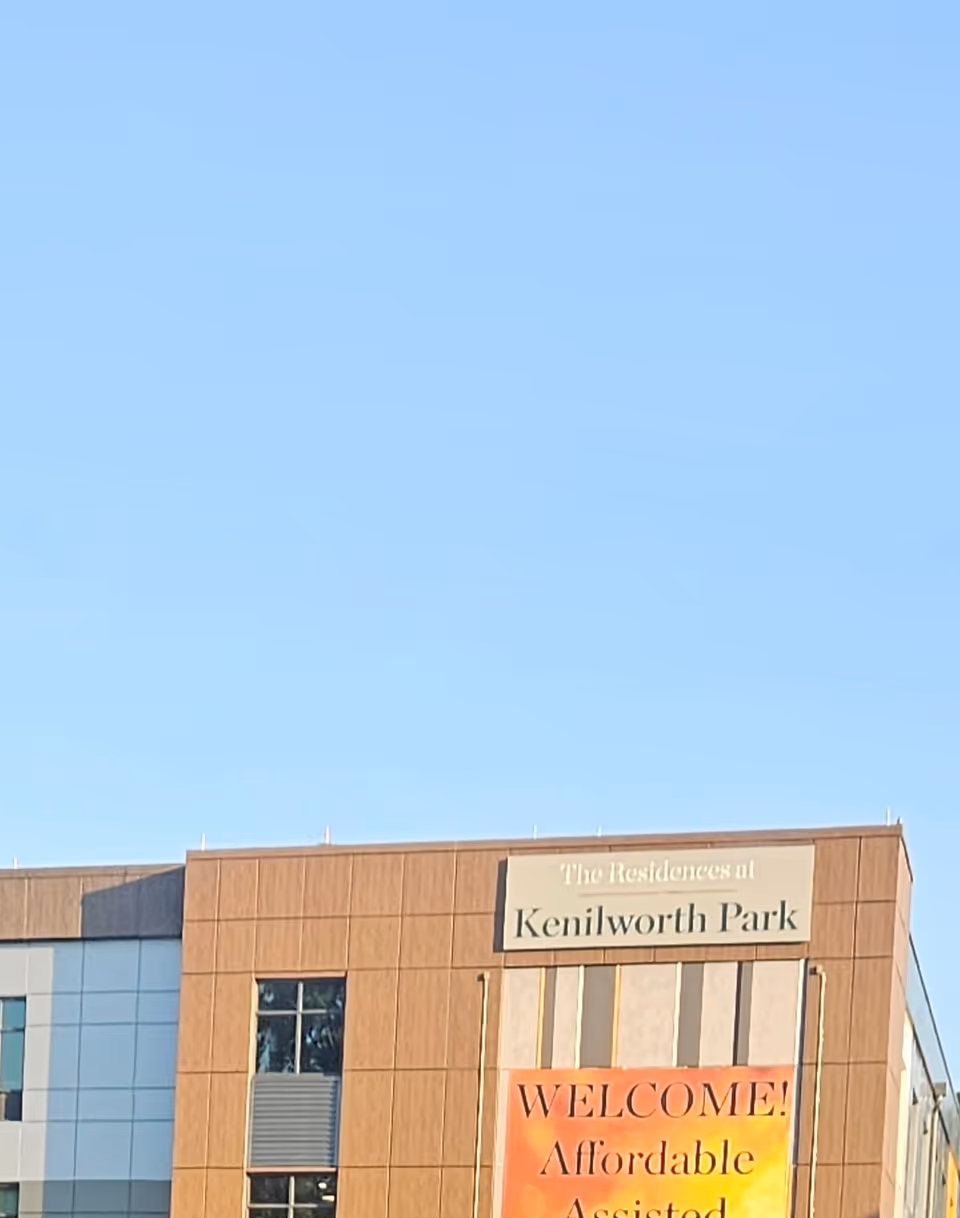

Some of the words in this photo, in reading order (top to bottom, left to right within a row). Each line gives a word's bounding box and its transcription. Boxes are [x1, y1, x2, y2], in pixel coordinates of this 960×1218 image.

[560, 862, 603, 885] The
[608, 859, 731, 883] Residences
[735, 859, 756, 880] at
[514, 903, 707, 939] Kenilworth
[720, 900, 799, 932] Park
[517, 1080, 789, 1118] WELCOME!
[540, 1139, 755, 1176] Affordable
